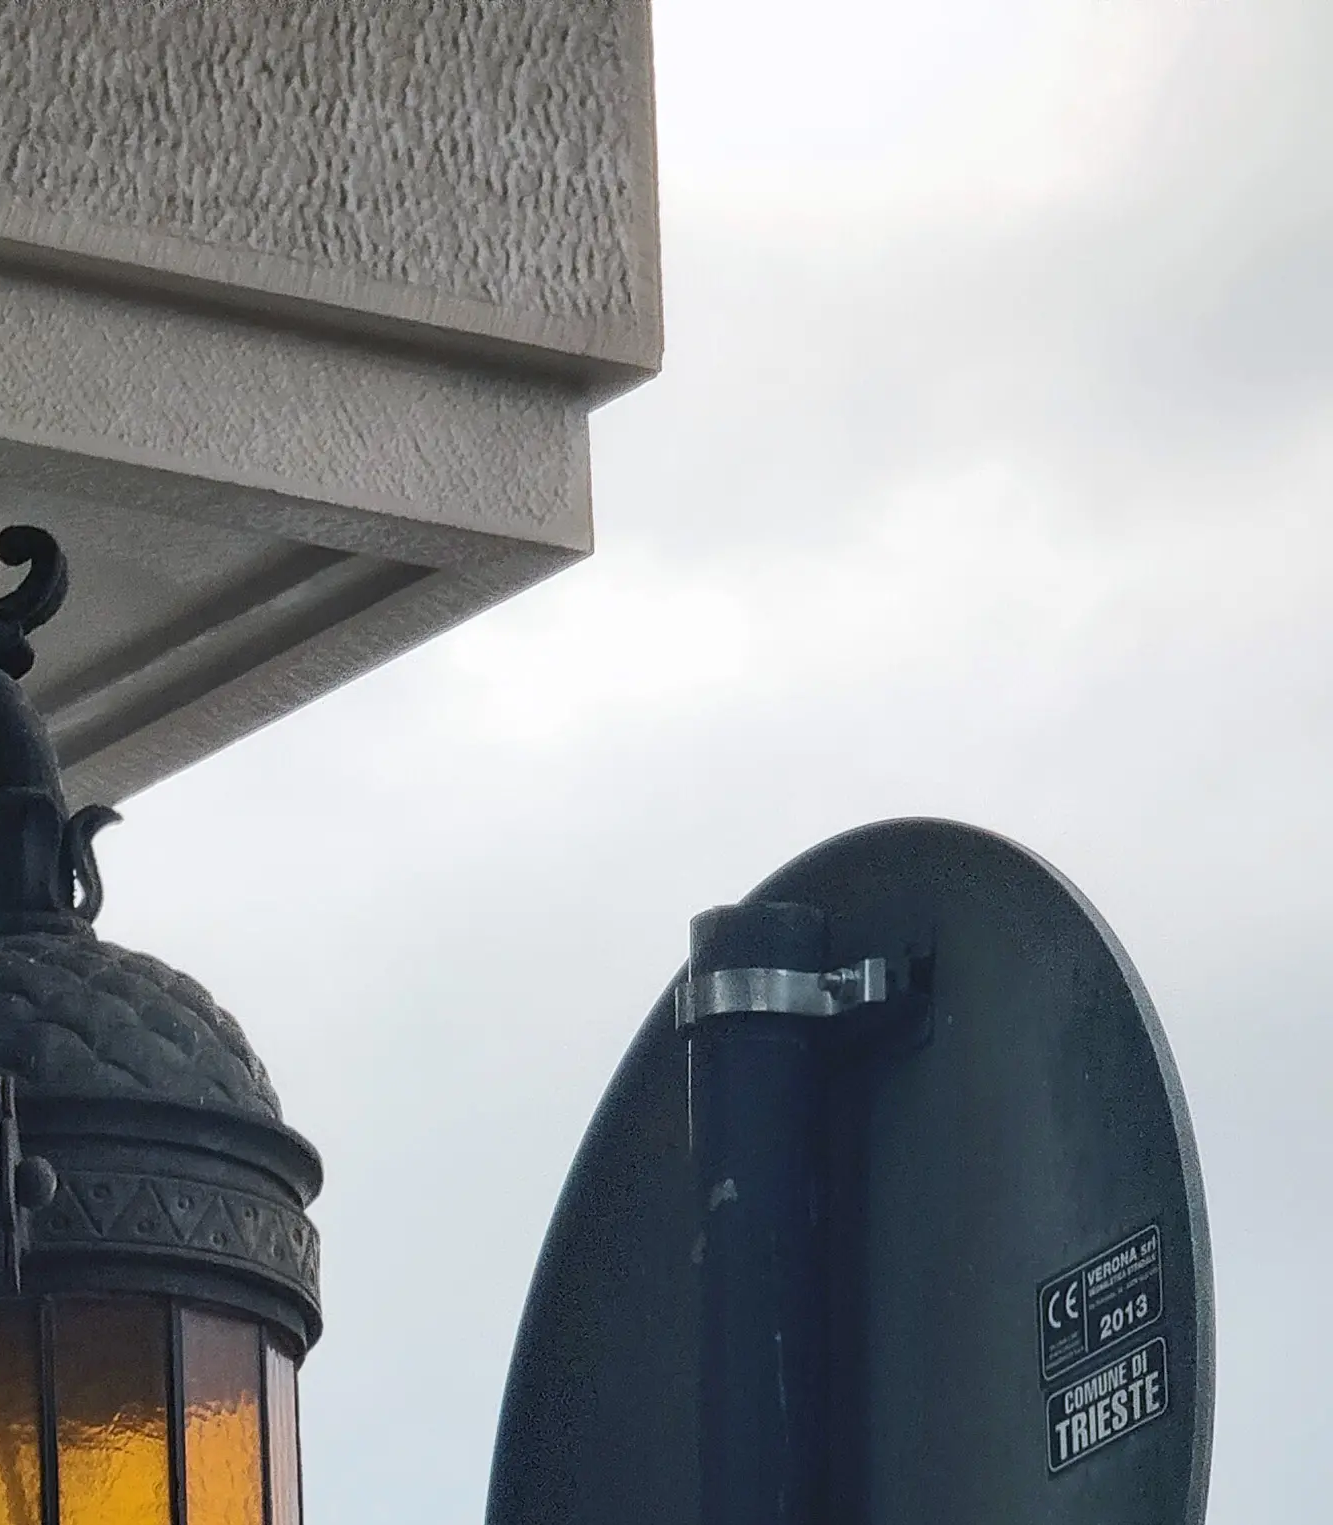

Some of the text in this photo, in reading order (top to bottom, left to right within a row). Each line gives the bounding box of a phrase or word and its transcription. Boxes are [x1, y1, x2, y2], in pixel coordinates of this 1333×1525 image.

[1087, 1234, 1156, 1286] VERONA srl
[1048, 1281, 1078, 1328] CE
[1100, 1293, 1148, 1341] 2013
[1064, 1350, 1148, 1415] COMUNE DI
[1055, 1371, 1160, 1461] TRIESTE
